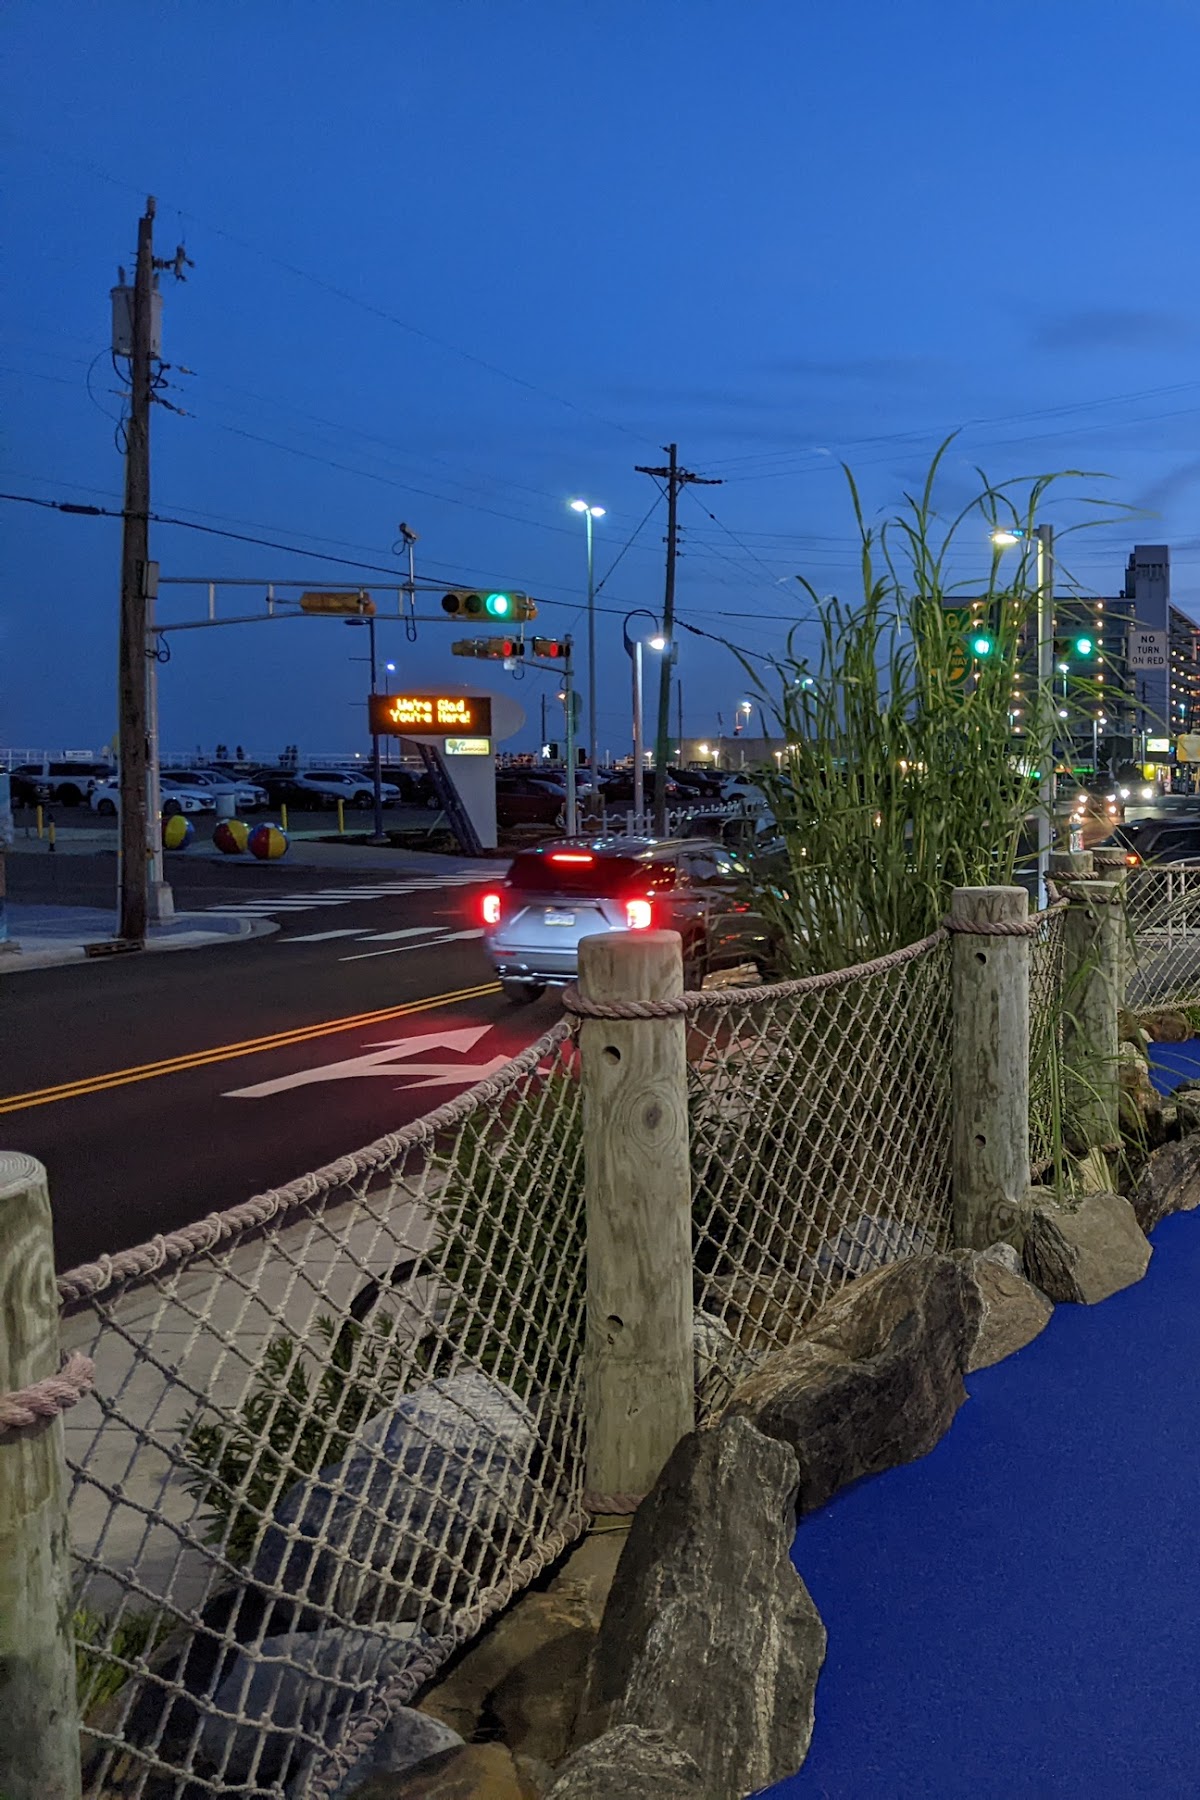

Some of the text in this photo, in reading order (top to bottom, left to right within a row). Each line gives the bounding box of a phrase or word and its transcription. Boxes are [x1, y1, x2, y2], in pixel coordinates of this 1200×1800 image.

[1141, 635, 1155, 643] NO
[1137, 646, 1160, 654] TURN
[1132, 656, 1164, 665] ON RED
[397, 699, 465, 712] We're Glad
[390, 709, 470, 723] You're Here!
